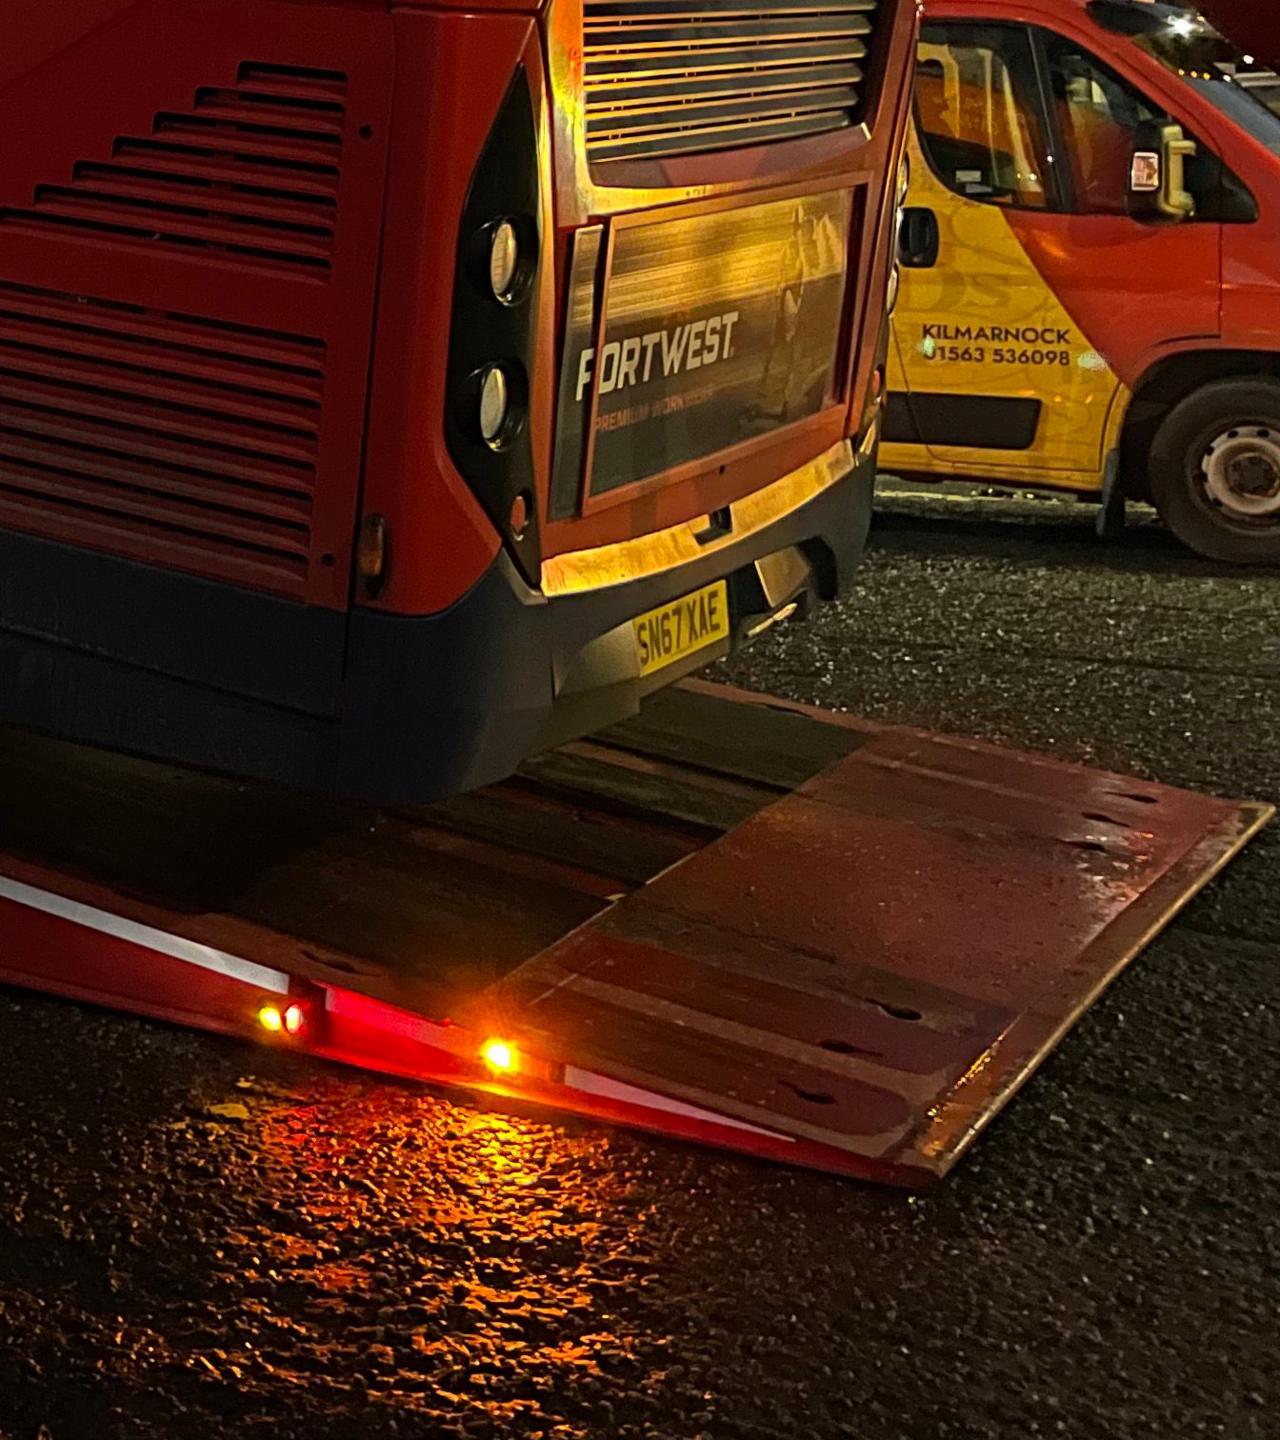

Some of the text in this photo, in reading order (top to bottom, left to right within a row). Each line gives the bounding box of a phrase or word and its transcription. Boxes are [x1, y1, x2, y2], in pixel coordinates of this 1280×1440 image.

[922, 324, 1071, 345] KILMARNOCK
[992, 348, 1070, 366] 536098
[637, 589, 720, 667] SN67 XAE
